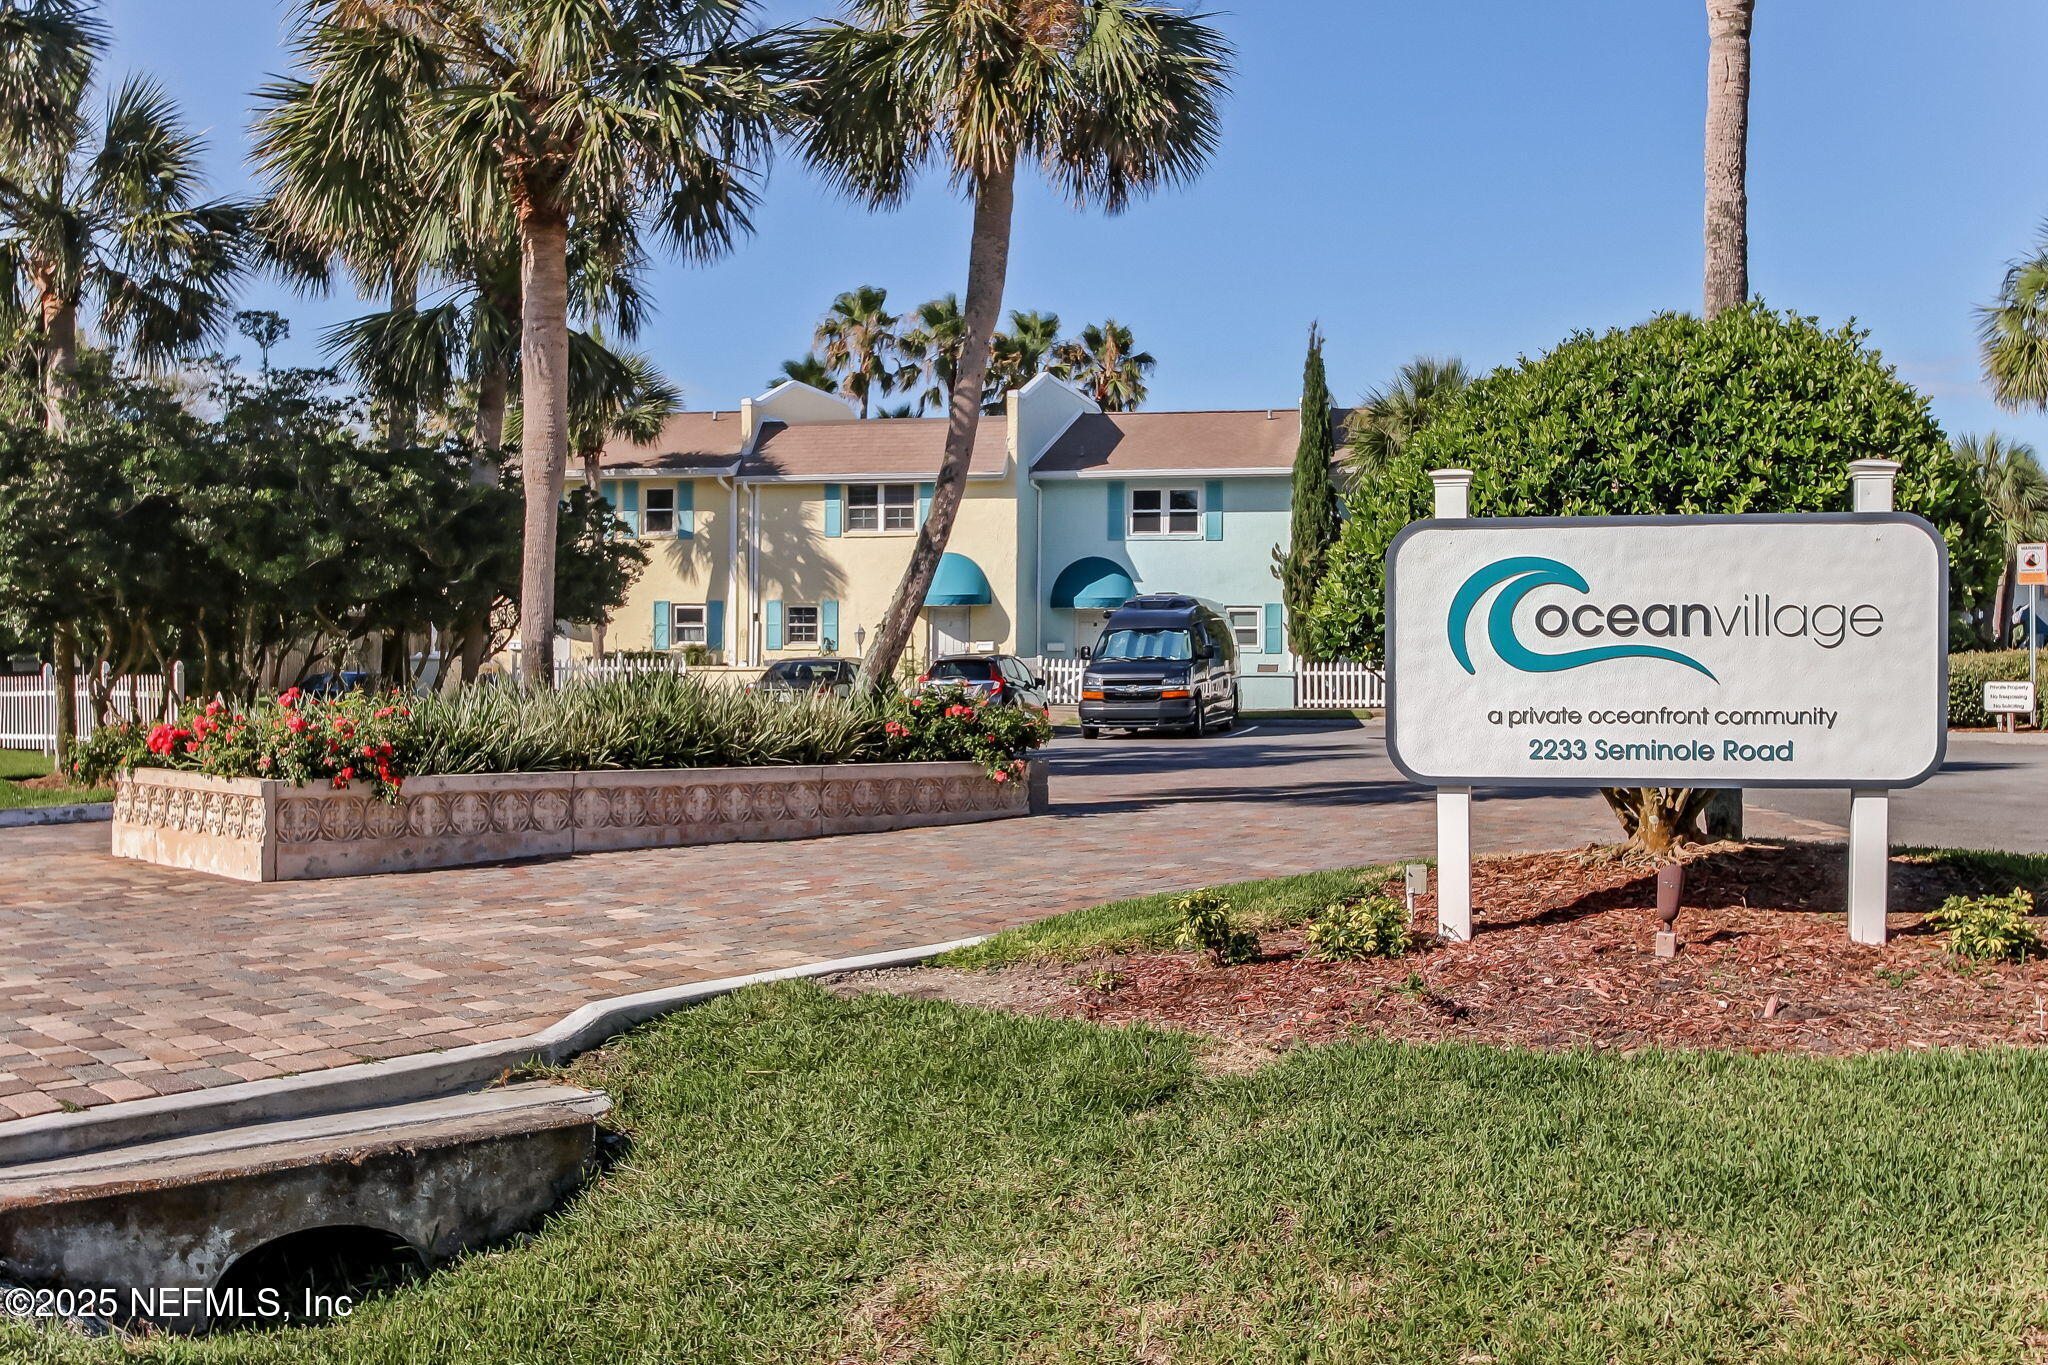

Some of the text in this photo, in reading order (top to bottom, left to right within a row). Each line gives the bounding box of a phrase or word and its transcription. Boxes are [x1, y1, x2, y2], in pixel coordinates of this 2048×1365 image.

[1487, 706, 1838, 730] a private oceanfront community
[1528, 738, 1794, 762] 2233 Seminole Road
